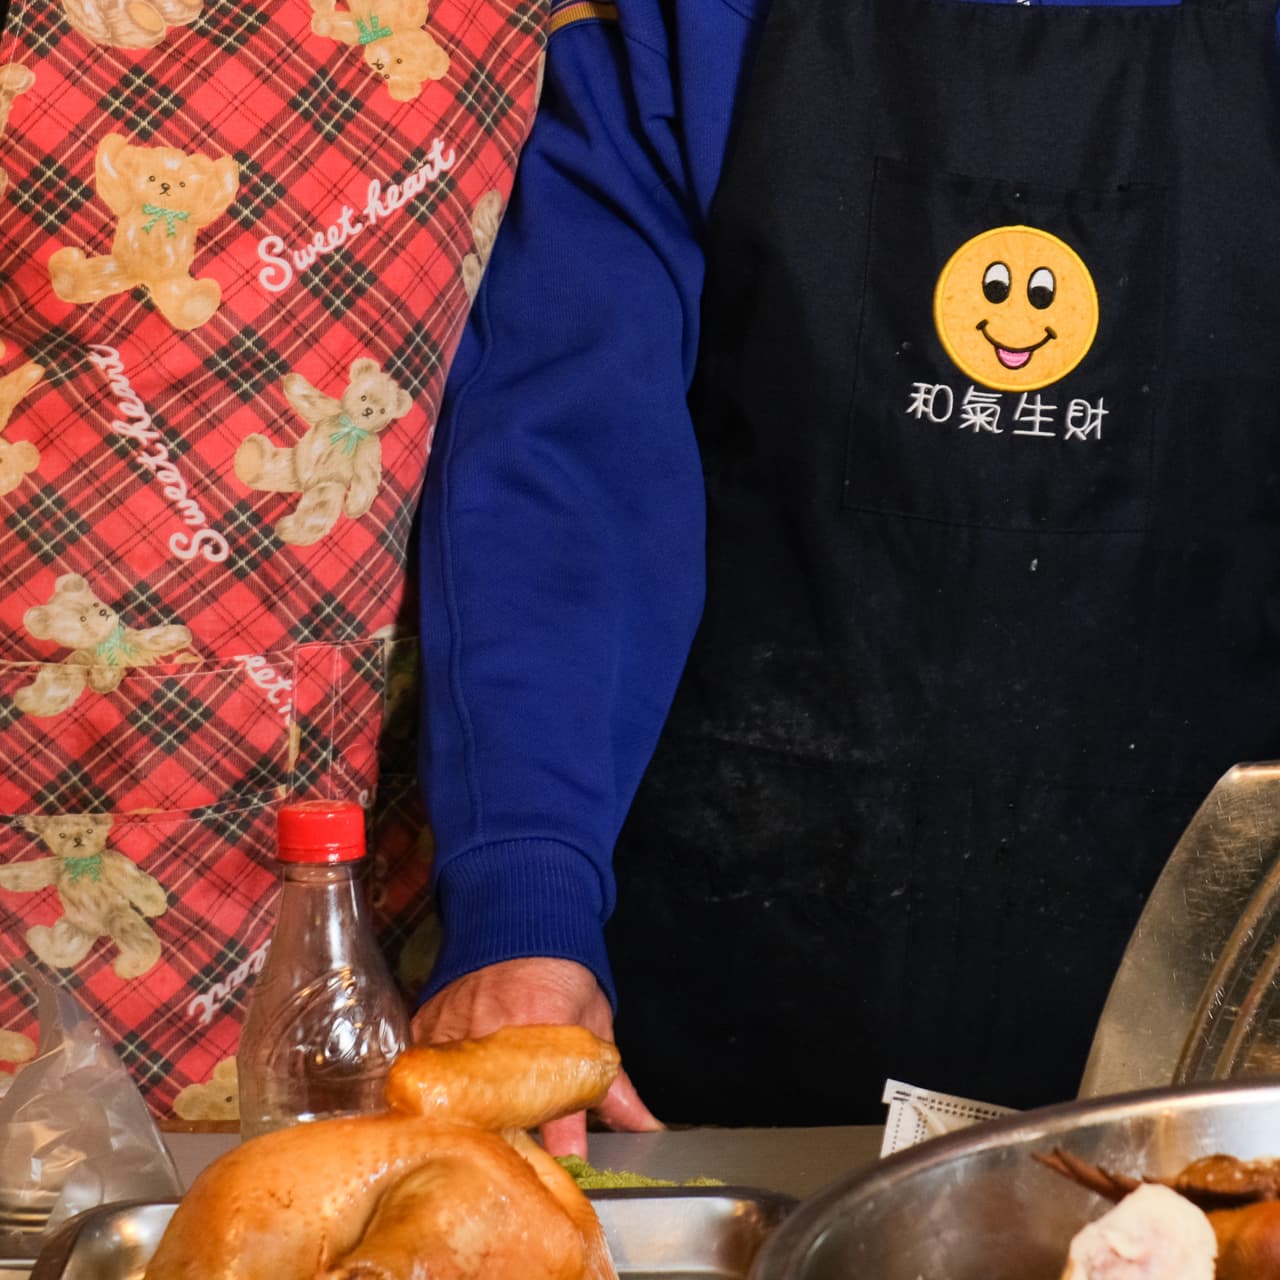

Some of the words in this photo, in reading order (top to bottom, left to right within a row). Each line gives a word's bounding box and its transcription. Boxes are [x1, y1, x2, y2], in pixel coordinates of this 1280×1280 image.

[257, 205, 363, 292] Sweet
[365, 137, 456, 224] heart
[87, 344, 162, 445] heart
[904, 381, 1110, 441] 和氣生財
[137, 442, 229, 563] Sweet
